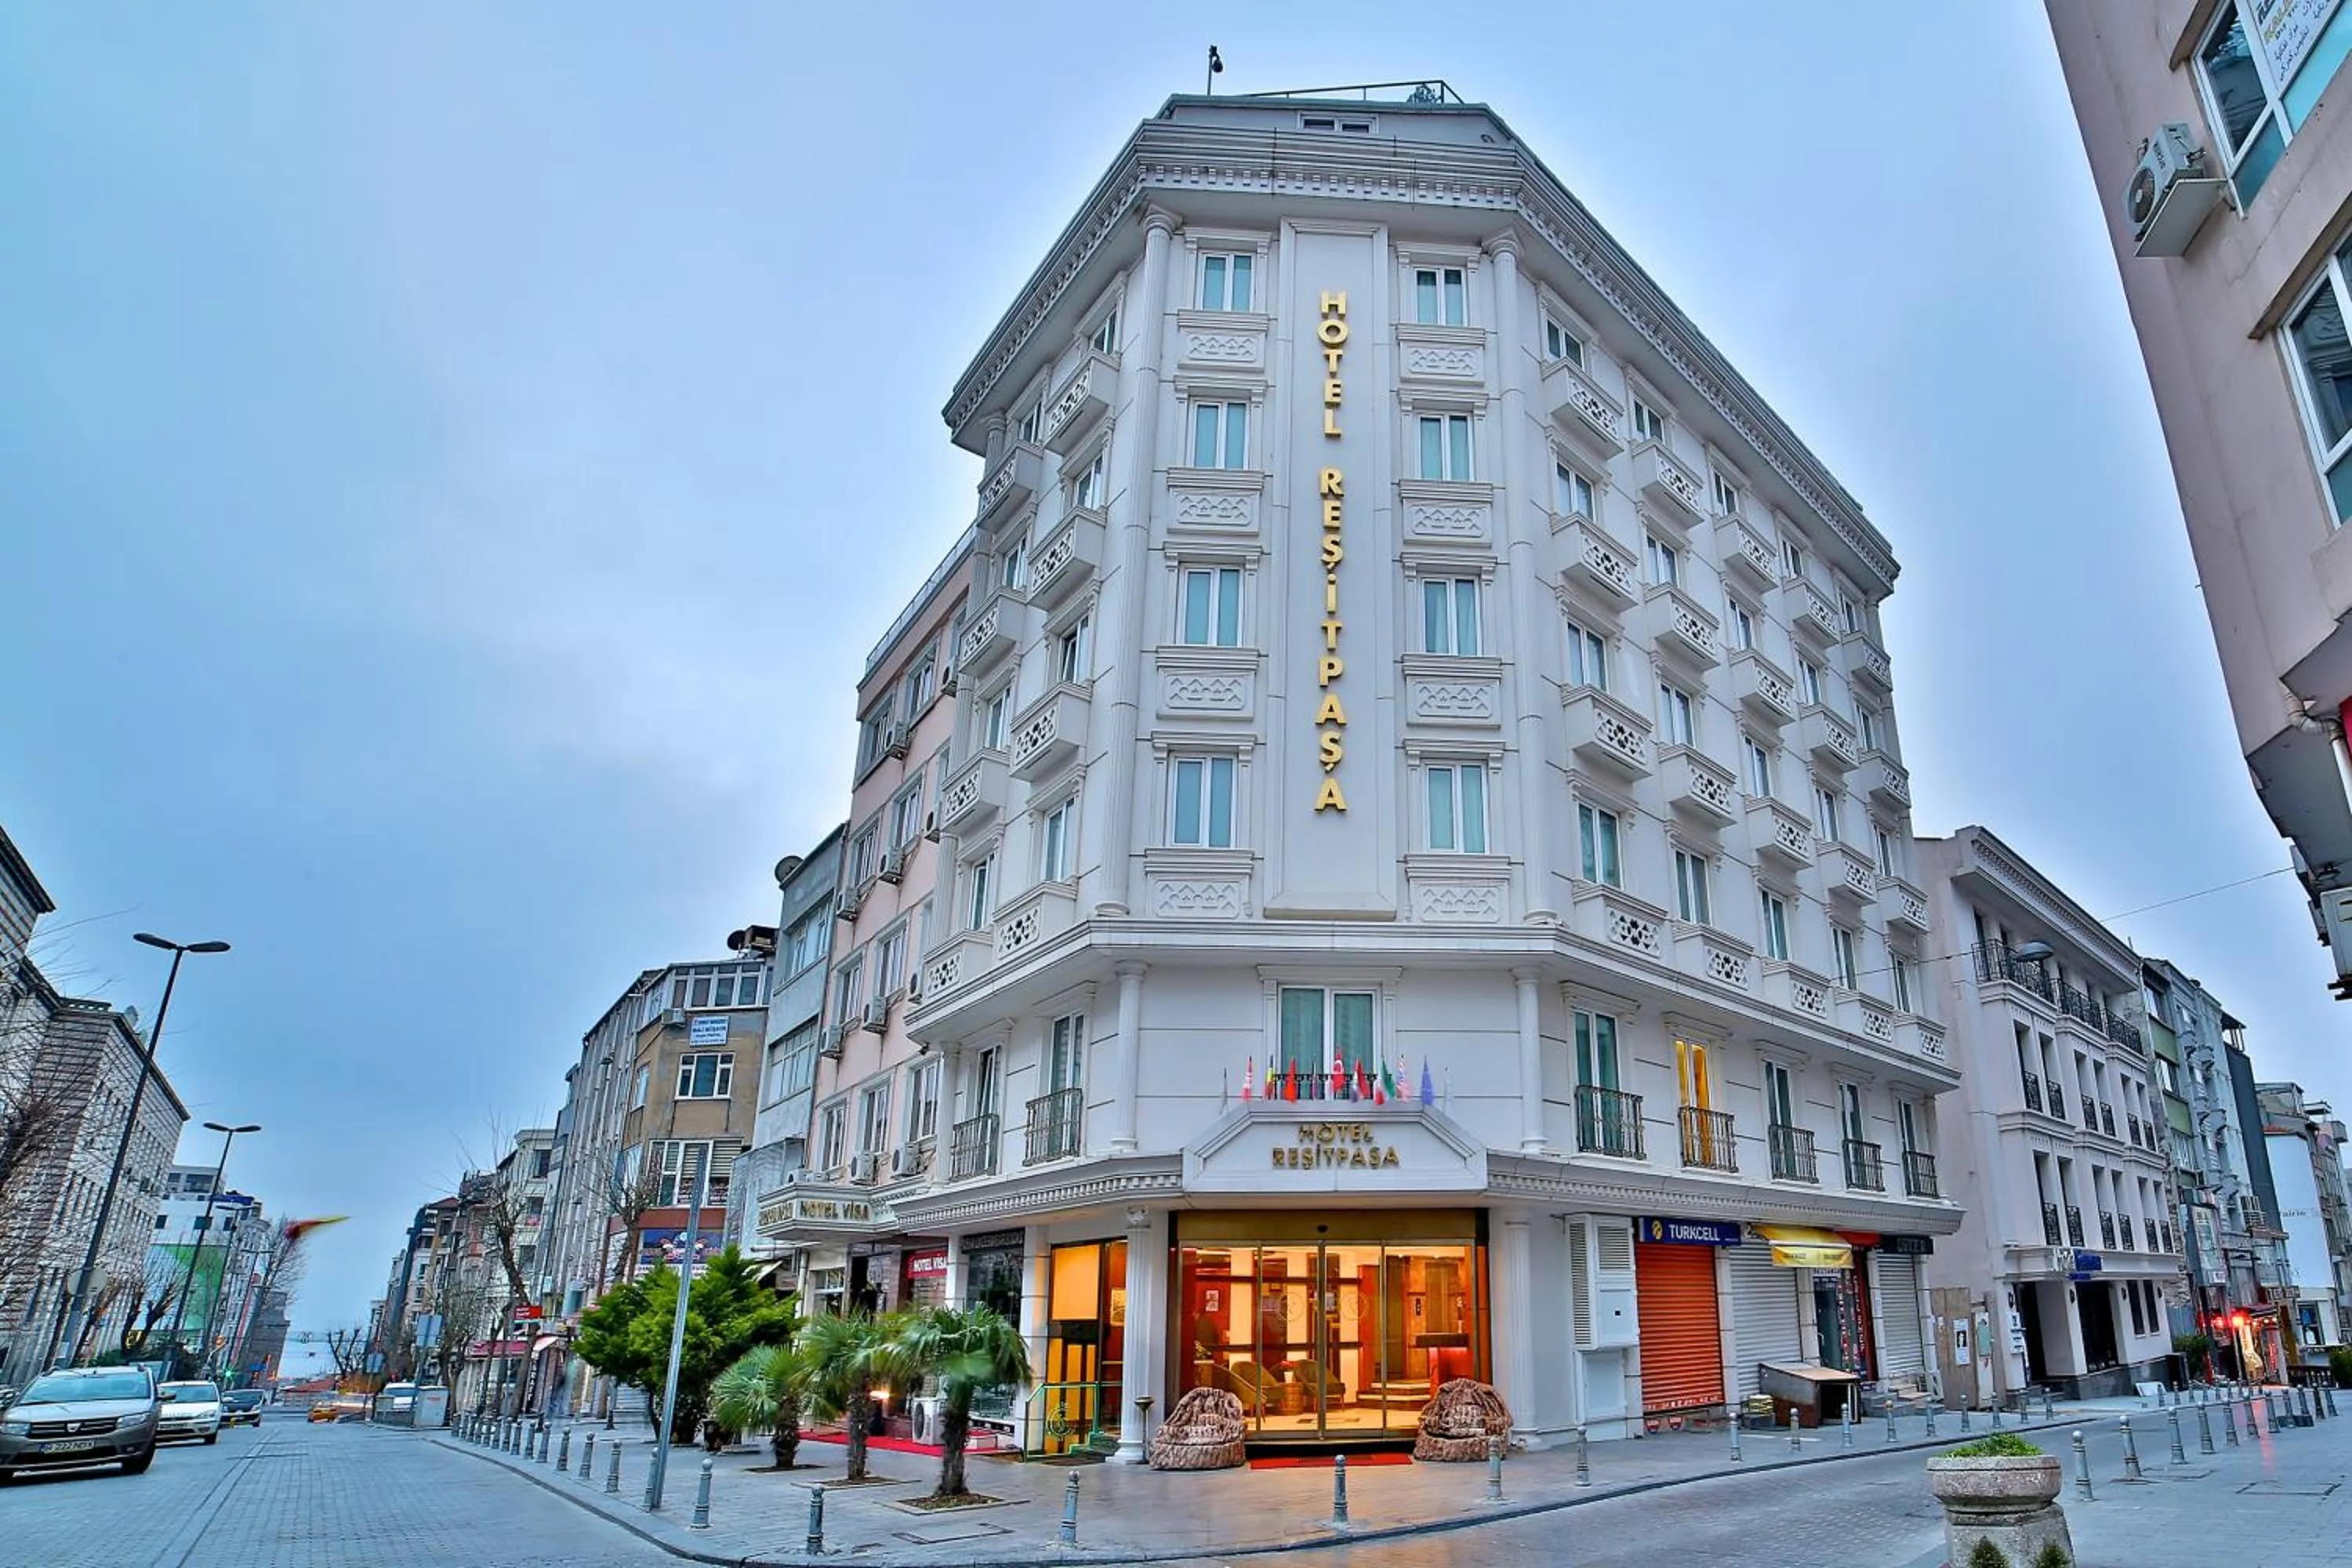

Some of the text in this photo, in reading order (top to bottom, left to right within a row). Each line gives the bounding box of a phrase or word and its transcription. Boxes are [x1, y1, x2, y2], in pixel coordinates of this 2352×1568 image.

[1317, 289, 1349, 438] HOTEL
[1314, 468, 1348, 811] REŞİTPAŞA
[1298, 1123, 1374, 1143] HOTEL
[1272, 1144, 1399, 1171] REŞİTPAŞA
[800, 1200, 838, 1218] HOTEL
[1668, 1224, 1721, 1241] TURKCELL
[913, 1258, 932, 1272] HOTEL
